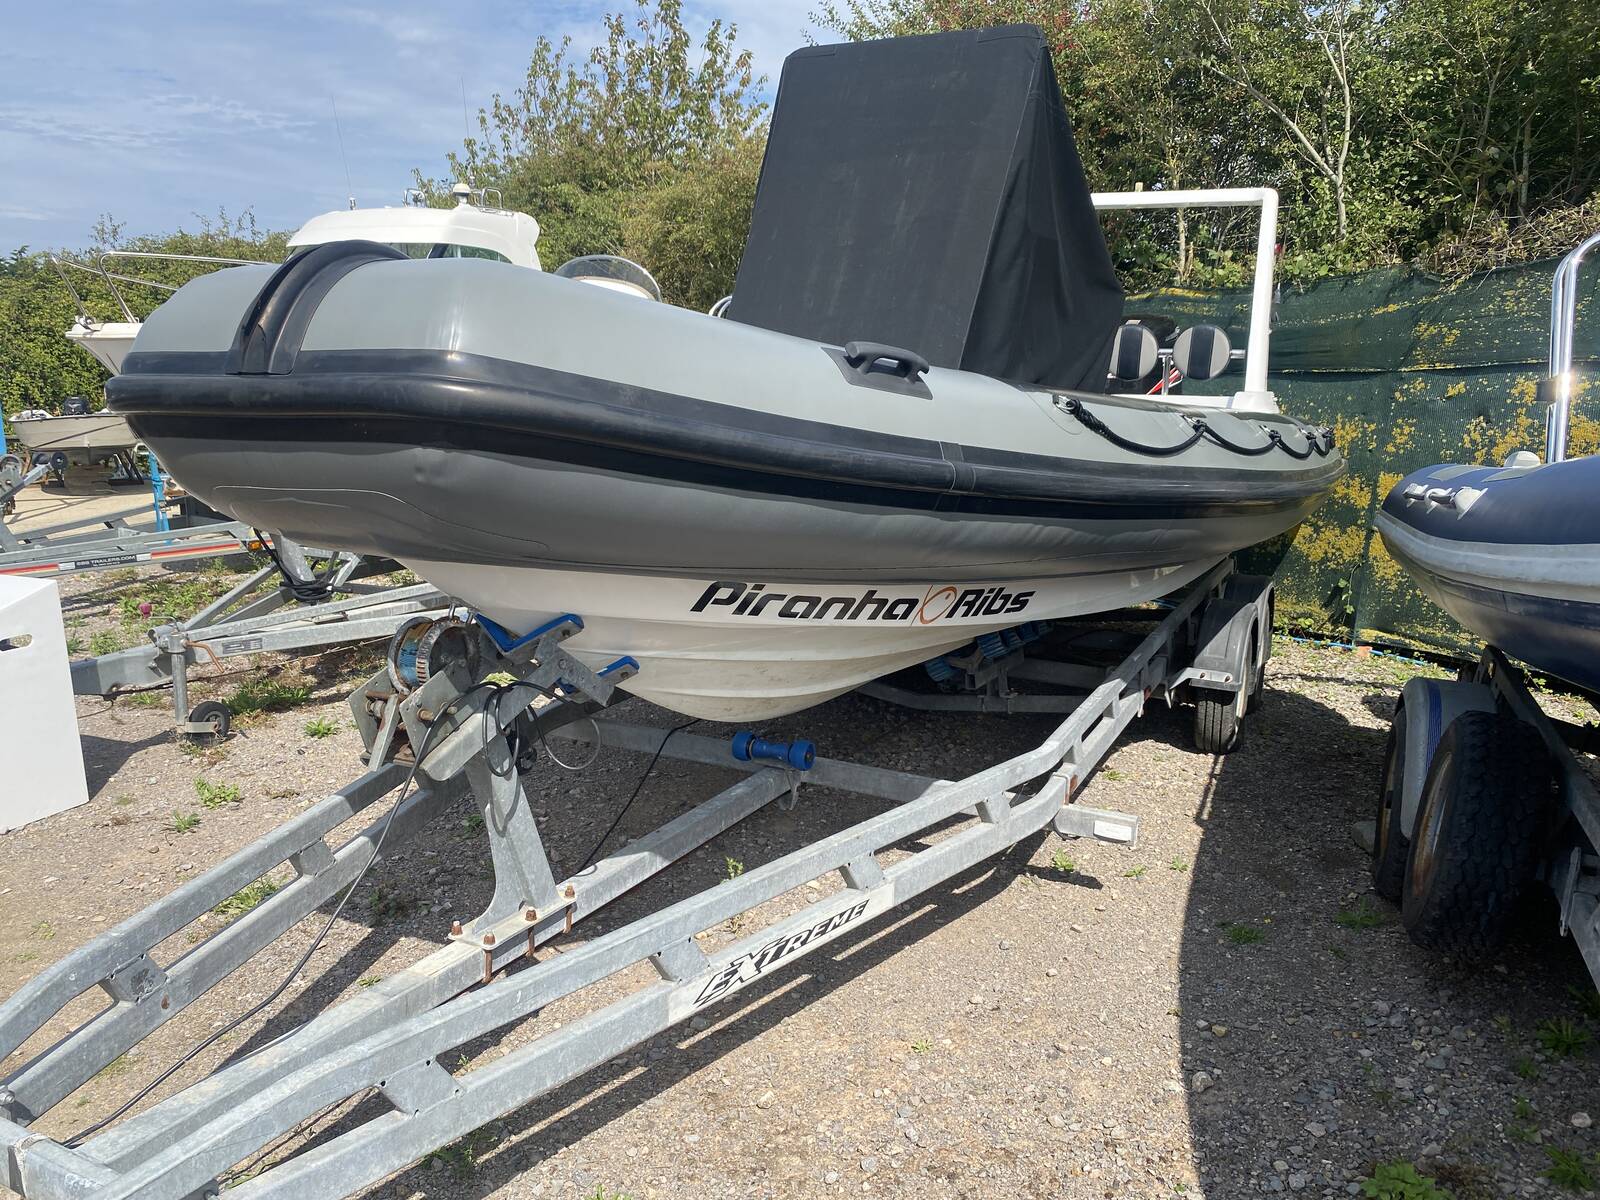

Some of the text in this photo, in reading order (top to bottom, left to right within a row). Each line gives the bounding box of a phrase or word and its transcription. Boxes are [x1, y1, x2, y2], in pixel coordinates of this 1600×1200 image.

[690, 581, 1037, 620] Piranha Ribs
[694, 899, 870, 1006] EXTREME
